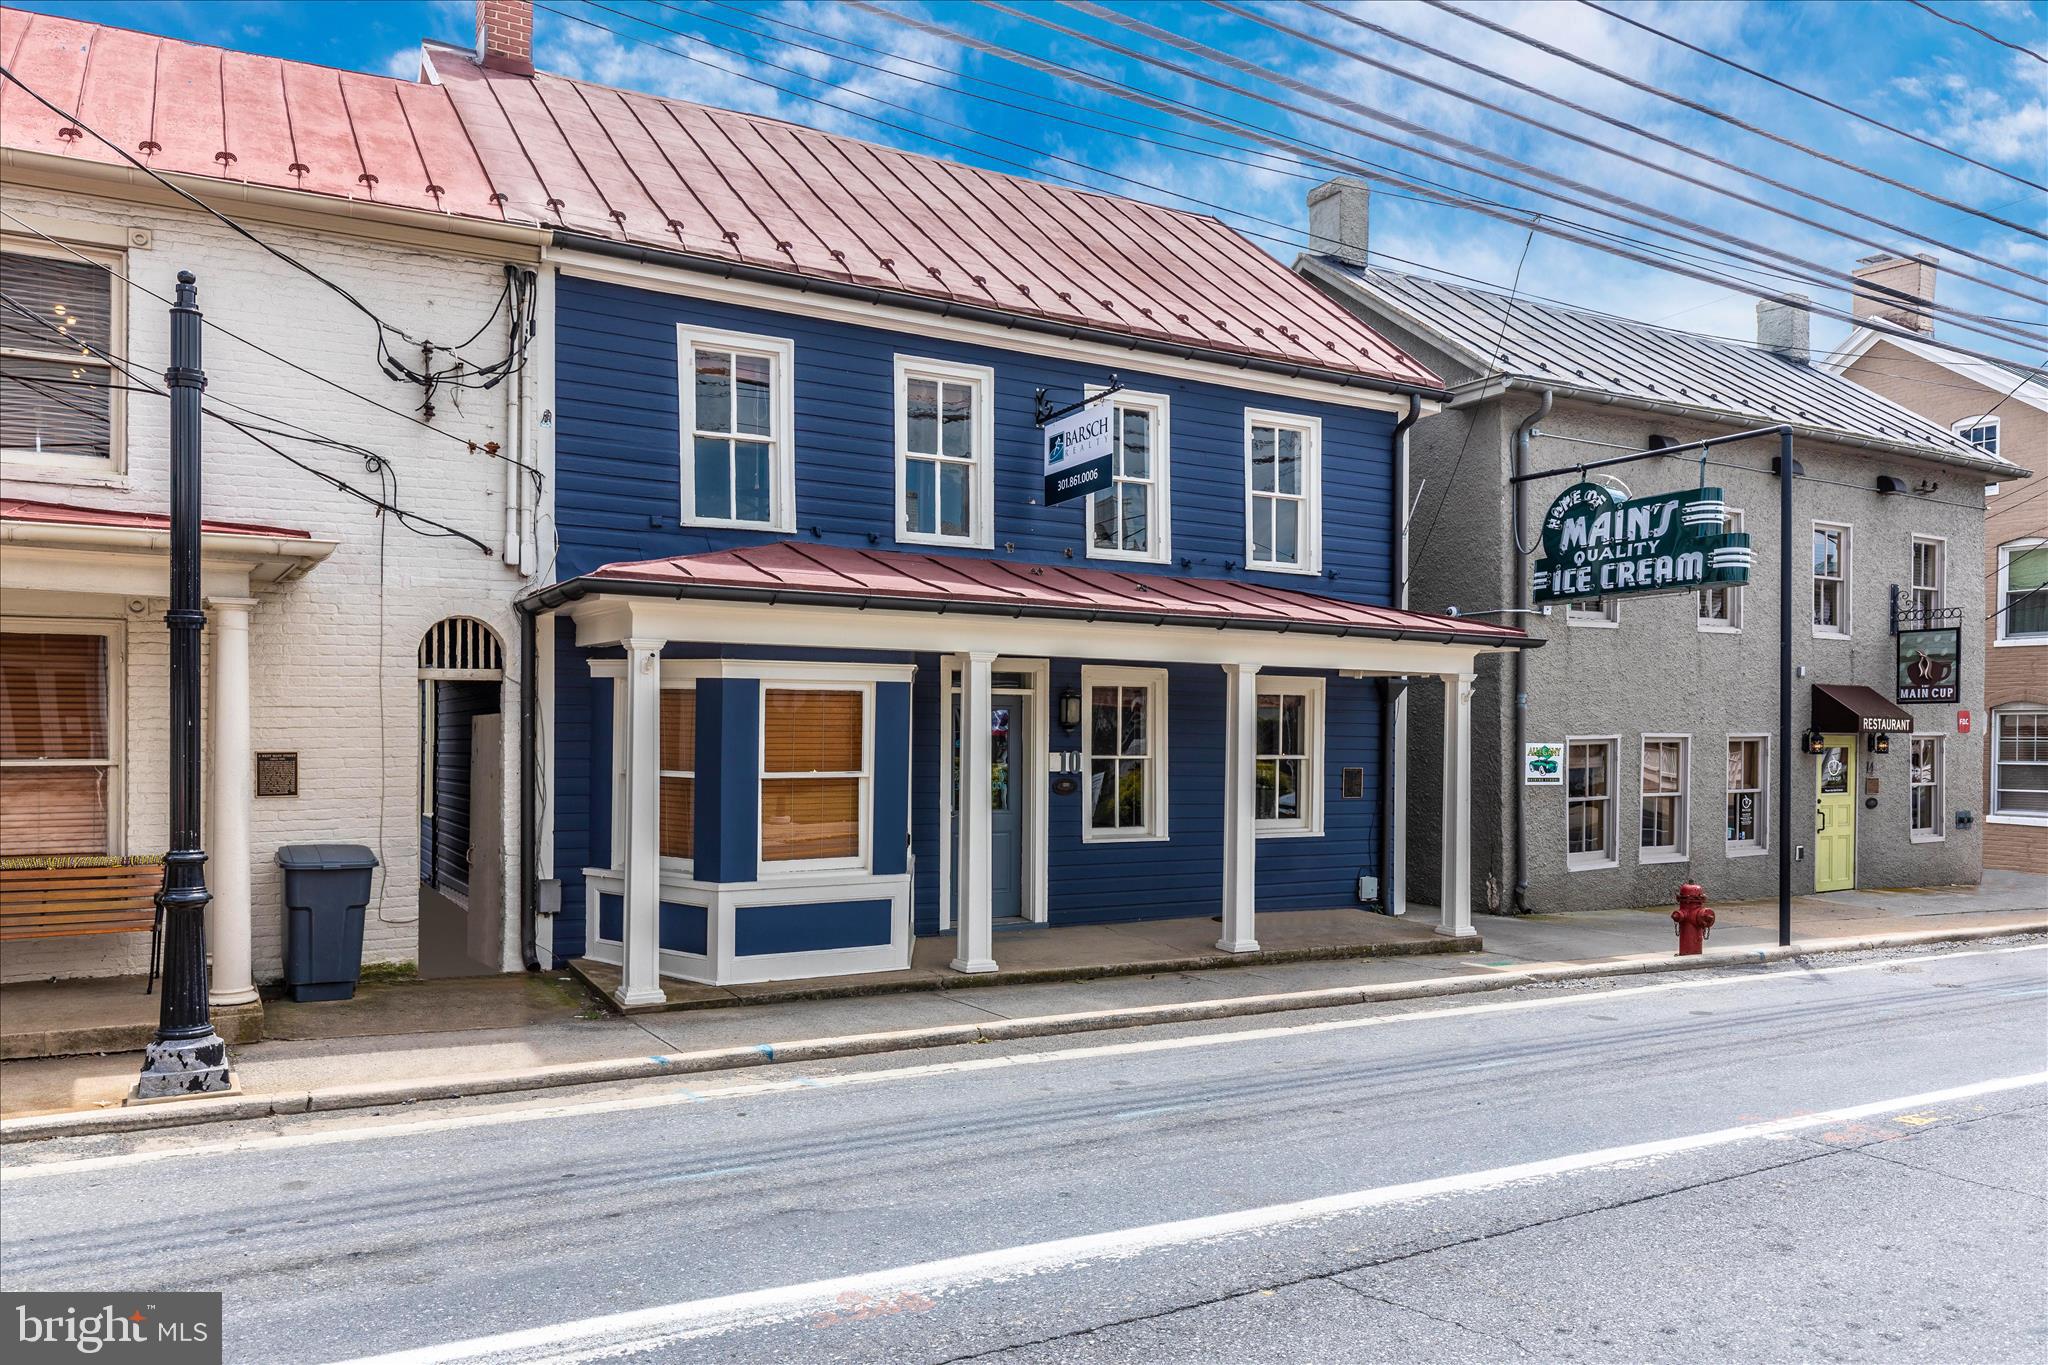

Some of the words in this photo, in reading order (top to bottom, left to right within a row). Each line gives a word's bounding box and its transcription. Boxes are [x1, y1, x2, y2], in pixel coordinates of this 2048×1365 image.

[1065, 417, 1108, 447] BARSCH
[1065, 435, 1108, 456] REALTY
[1057, 468, 1098, 491] 301.861.0006
[1547, 489, 1582, 530] HOME
[1584, 488, 1607, 511] OF
[1573, 540, 1661, 566] QUALITY
[1553, 566, 1592, 595] ICE
[1600, 551, 1704, 590] CREAM
[1900, 688, 1929, 699] MAIN
[1931, 687, 1954, 698] CUP
[1863, 718, 1910, 731] RESTAURANT
[1060, 750, 1081, 774] 10
